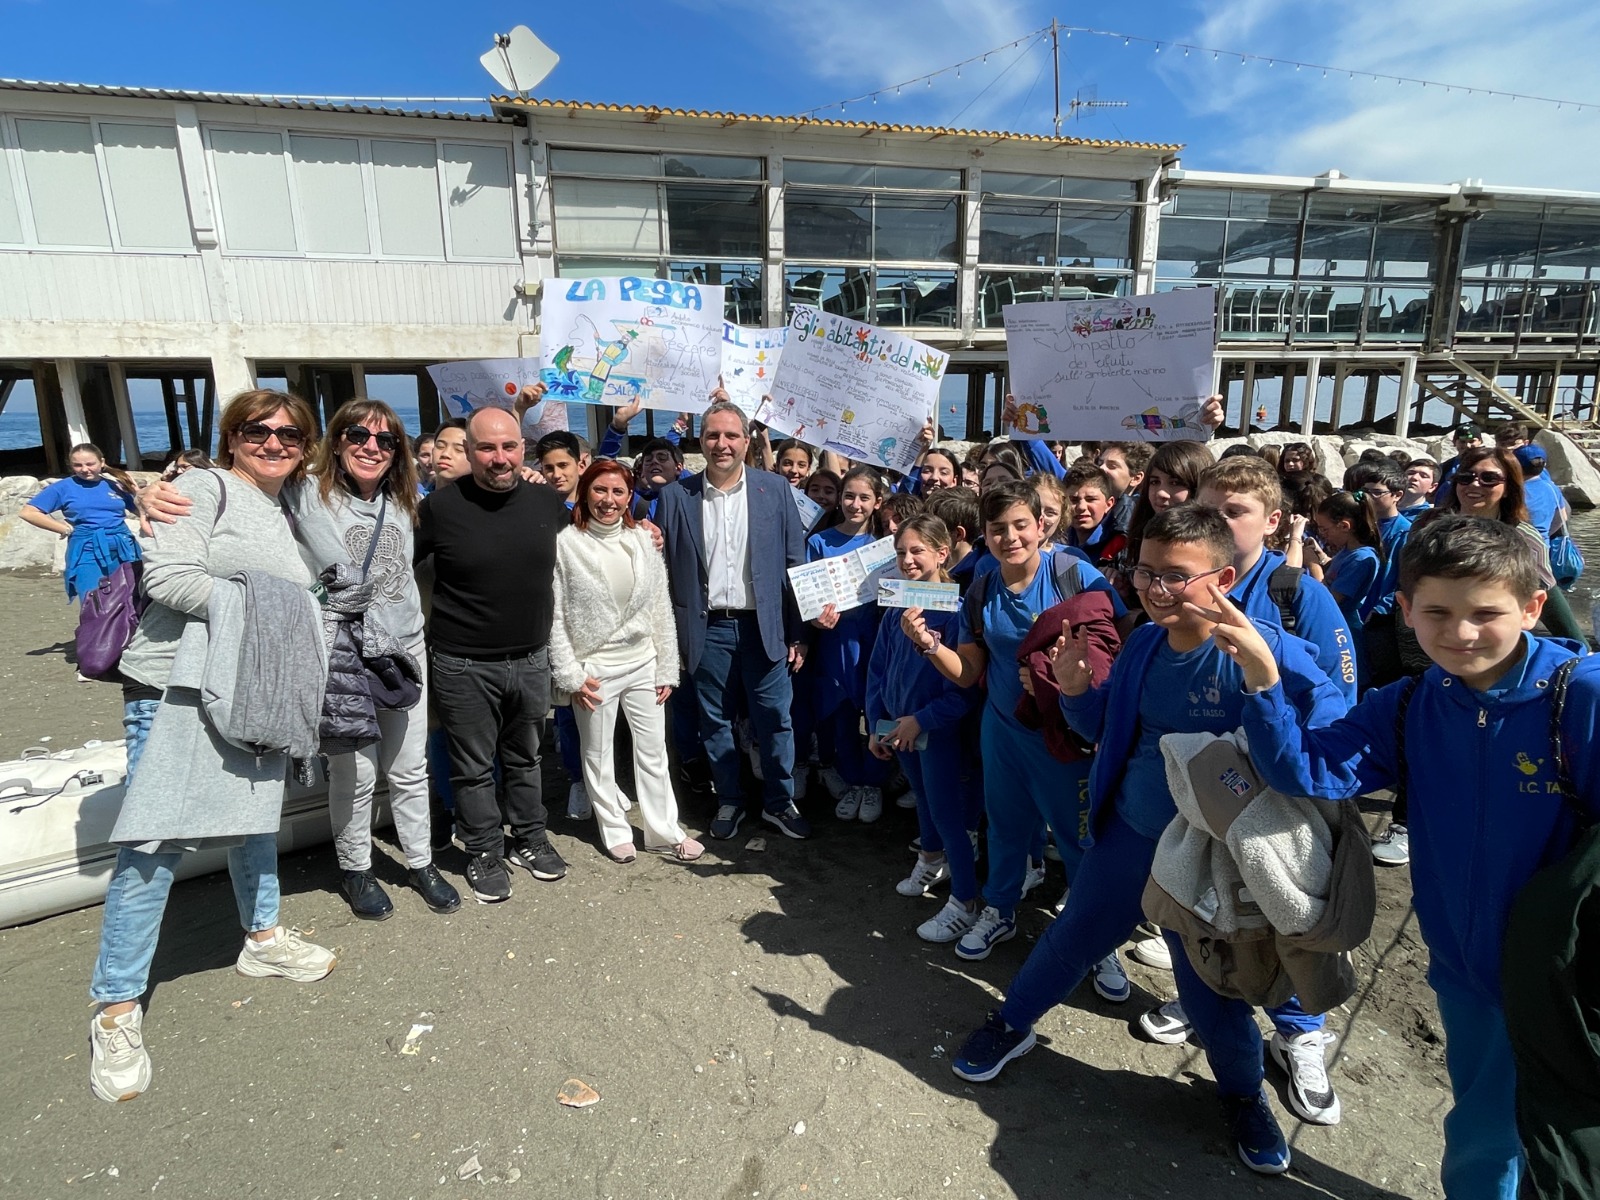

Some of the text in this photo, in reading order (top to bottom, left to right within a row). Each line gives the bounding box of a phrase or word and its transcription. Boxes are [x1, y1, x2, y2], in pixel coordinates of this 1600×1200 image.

[566, 276, 702, 311] LA PESCA
[662, 329, 716, 356] Pescare
[722, 322, 748, 348] IL
[827, 317, 886, 358] abitanti
[890, 341, 913, 369] del
[1054, 325, 1136, 360] Impatto
[440, 366, 540, 388] Cosa possiamo fare
[846, 356, 871, 372] PESCI
[1134, 368, 1166, 376] marino
[876, 417, 910, 434] CETACEI
[1334, 628, 1355, 684] I.C. TASSO
[1188, 708, 1226, 718] I.C. TASSO
